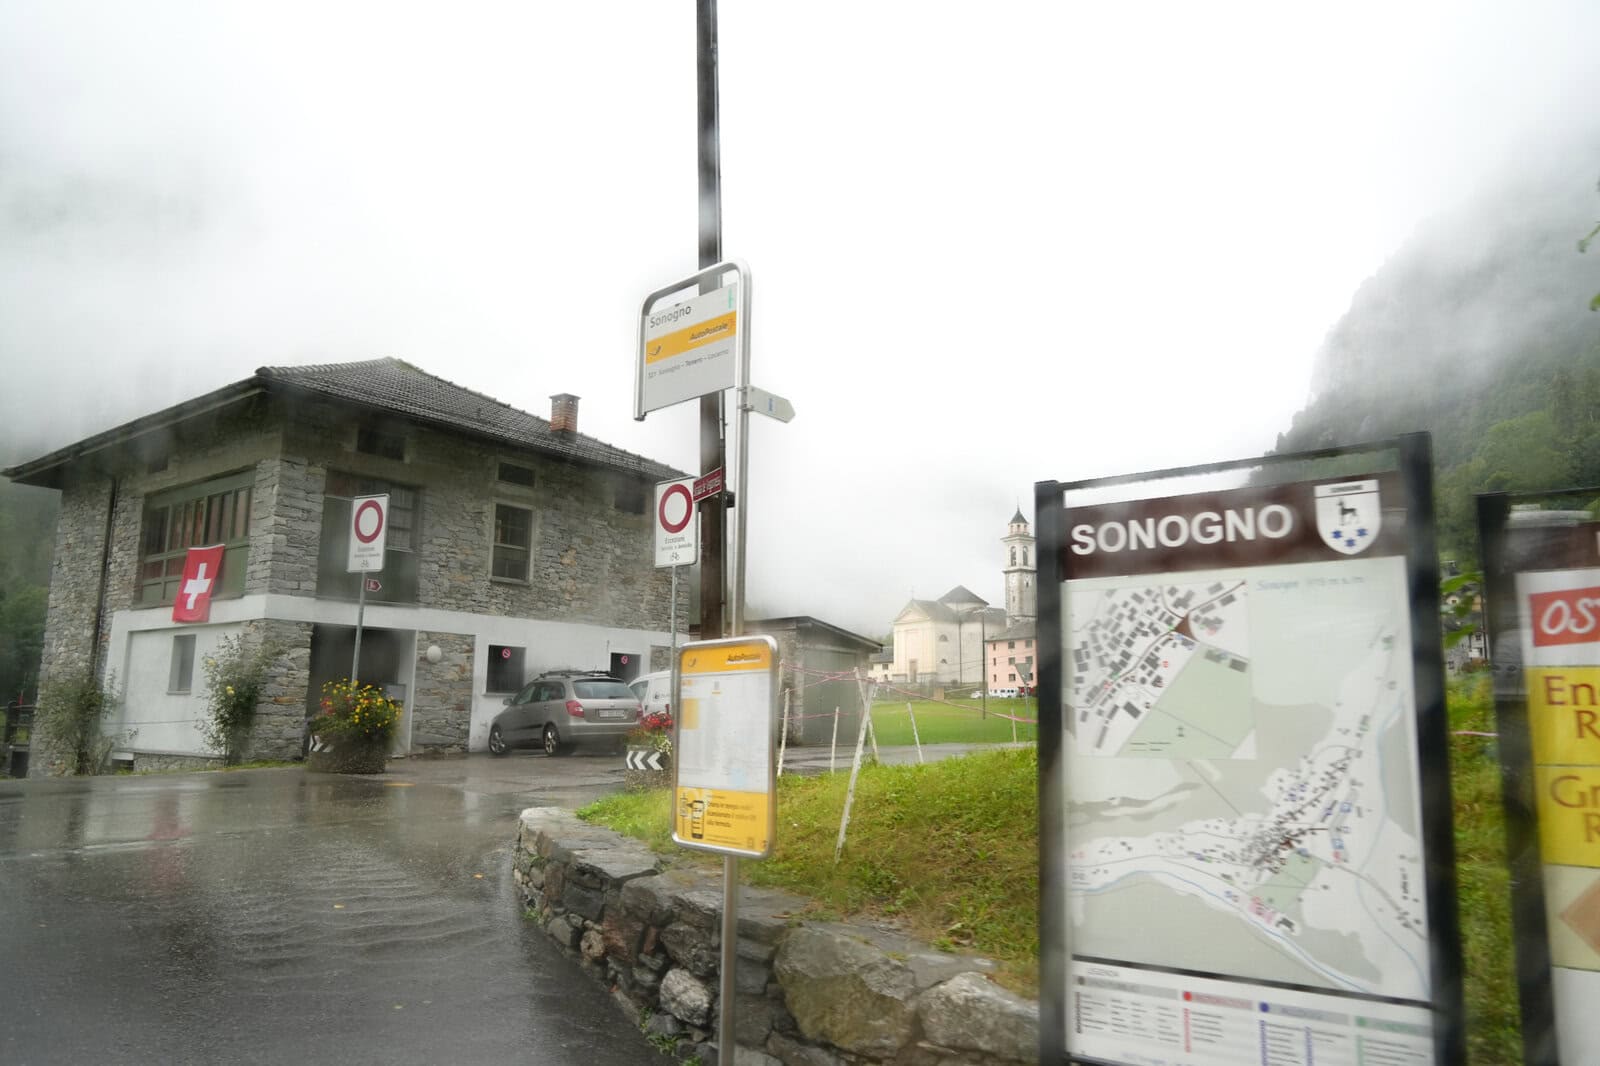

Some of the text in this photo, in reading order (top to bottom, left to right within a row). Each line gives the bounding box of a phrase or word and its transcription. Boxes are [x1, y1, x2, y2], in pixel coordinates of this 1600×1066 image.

[650, 306, 691, 328] Sonogno
[690, 323, 728, 340] AutoPostale
[1071, 504, 1293, 555] SONOGNO
[1543, 675, 1600, 706] En
[1575, 710, 1600, 739] R
[1584, 813, 1600, 843] R
